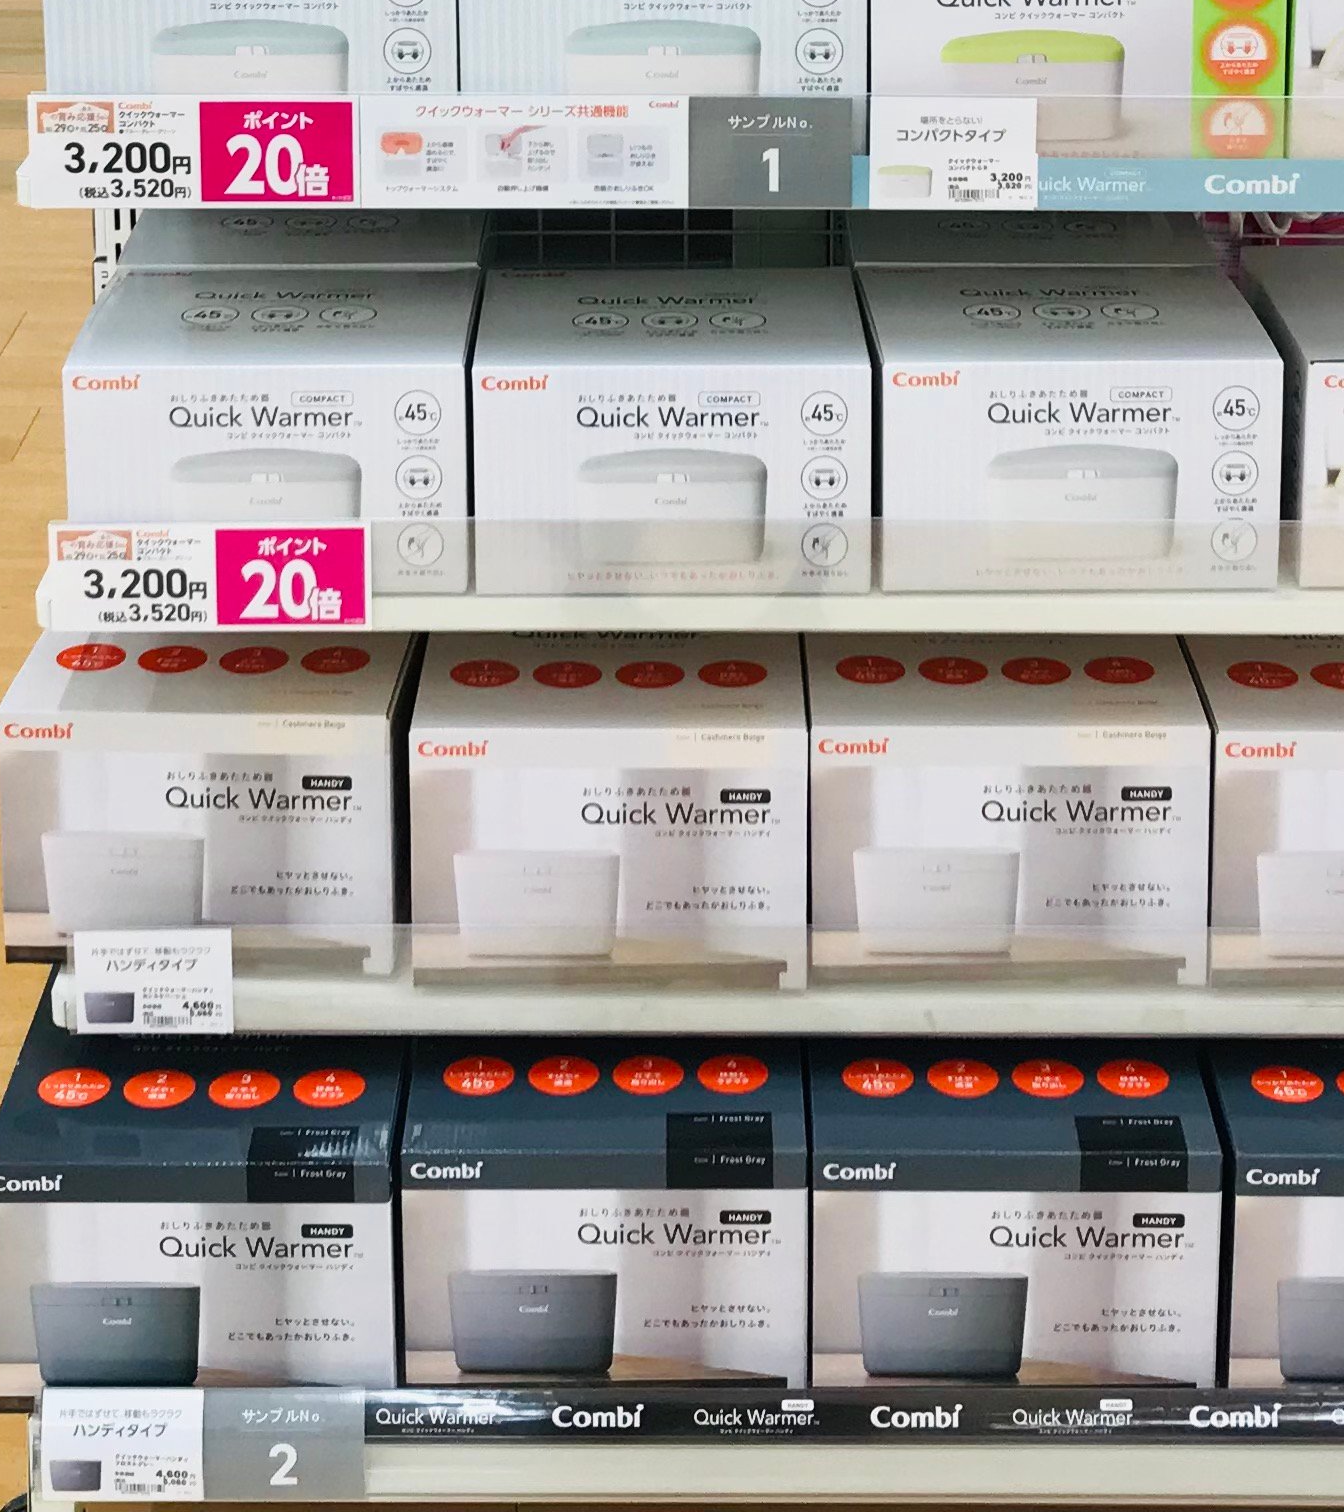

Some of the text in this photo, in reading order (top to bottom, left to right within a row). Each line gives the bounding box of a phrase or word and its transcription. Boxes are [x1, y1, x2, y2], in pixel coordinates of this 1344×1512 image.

[243, 112, 313, 130] ポイント
[897, 129, 1006, 142] コンパクトタイプ
[65, 142, 191, 175] 3,200円
[224, 134, 330, 196] 20倍
[761, 147, 780, 192] 1
[1205, 173, 1300, 195] Combi
[893, 370, 960, 387] Combi
[299, 395, 346, 403] COMPACT
[1118, 391, 1164, 399] COMPACT
[988, 402, 1172, 424] Quick Warmer
[258, 537, 327, 556] ポイント
[84, 568, 207, 600] 3,200円
[240, 559, 342, 619] 20倍
[4, 723, 74, 739] Combi
[818, 739, 890, 755] Combi
[311, 779, 344, 787] HANDY
[166, 787, 352, 811] Quick Warmer
[982, 800, 1171, 823] Quick Warmer
[106, 959, 197, 972] ハンディタイプ
[411, 1161, 483, 1179] Combi
[823, 1163, 896, 1180] Combi
[1246, 1168, 1319, 1186] Combi
[1141, 1217, 1177, 1226] HANDY
[578, 1223, 771, 1245] Quick Warmer
[552, 1404, 645, 1428] Combi
[870, 1404, 963, 1428] Combi
[73, 1423, 166, 1438] ハンディタイプ
[269, 1443, 298, 1486] 2
